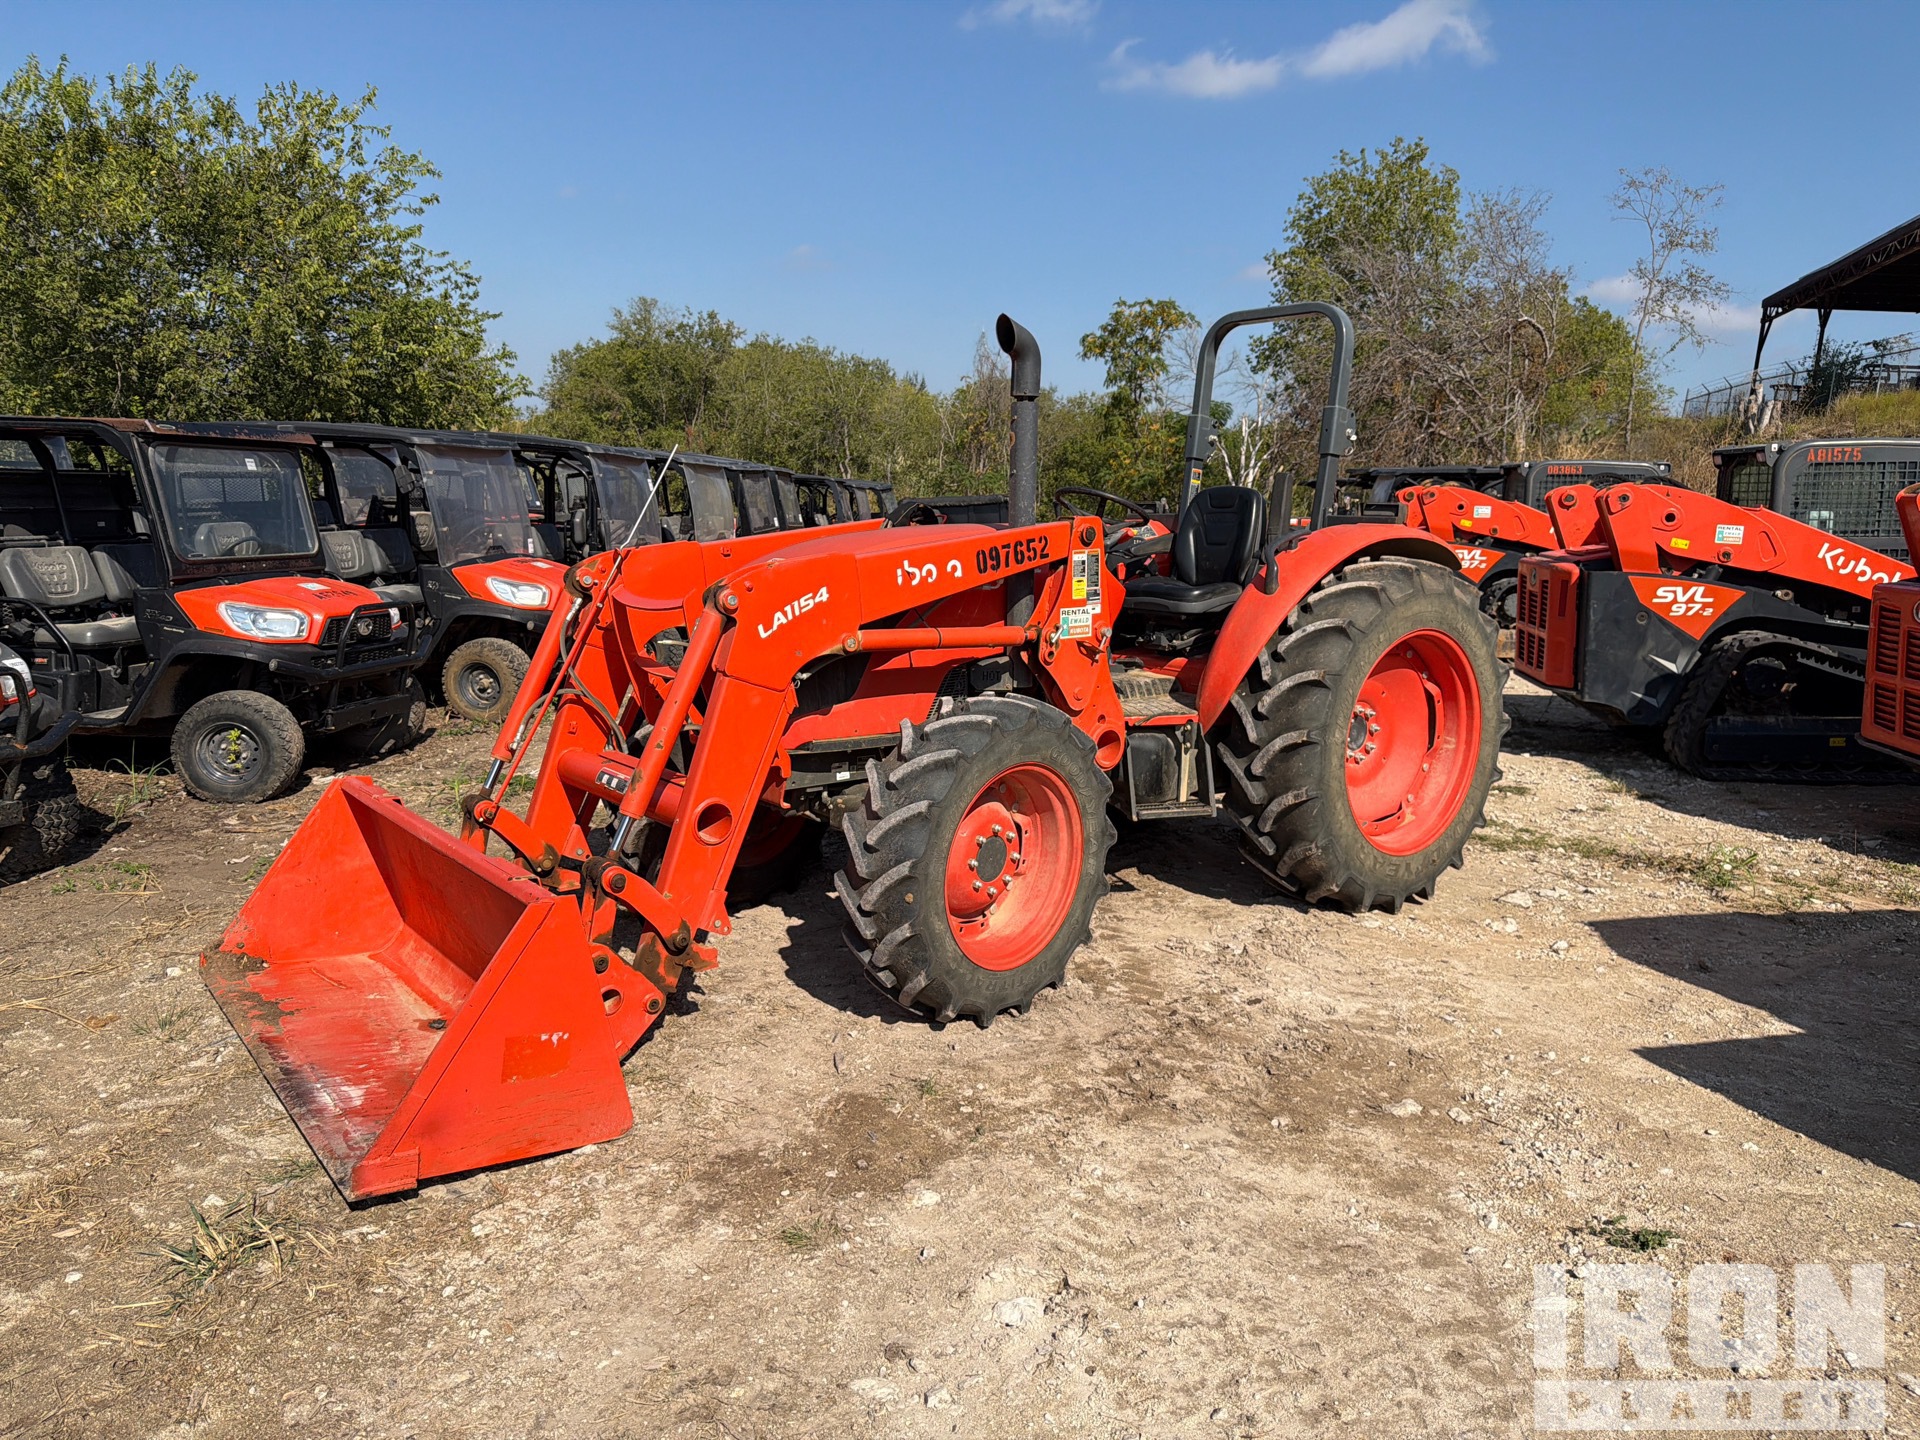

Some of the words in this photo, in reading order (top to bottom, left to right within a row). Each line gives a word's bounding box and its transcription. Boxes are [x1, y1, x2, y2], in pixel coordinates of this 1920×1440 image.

[1807, 447, 1862, 462] A81575
[976, 535, 1049, 575] 097652
[1652, 586, 1714, 603] SVL
[757, 586, 829, 639] LA1154
[1061, 608, 1091, 616] RENTAL
[1669, 603, 1714, 616] 97-2
[1050, 745, 1099, 876] GOODYEAR
